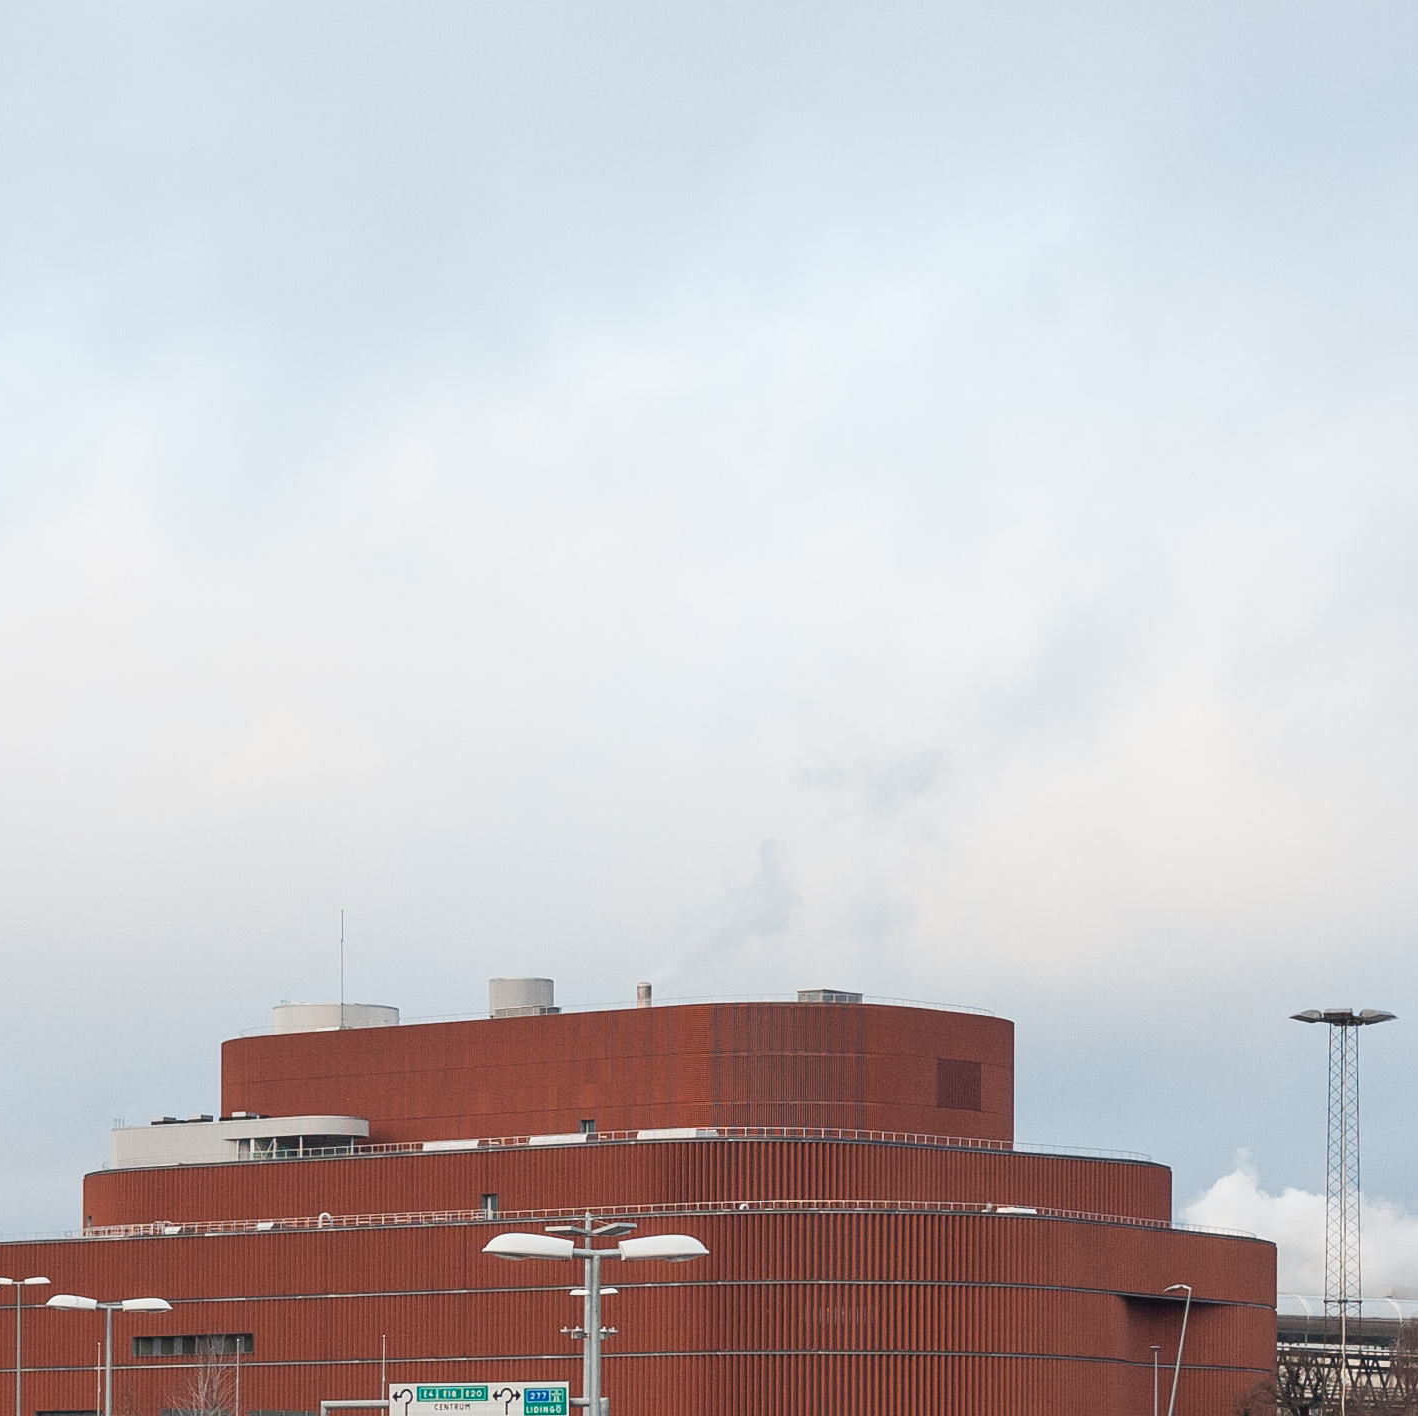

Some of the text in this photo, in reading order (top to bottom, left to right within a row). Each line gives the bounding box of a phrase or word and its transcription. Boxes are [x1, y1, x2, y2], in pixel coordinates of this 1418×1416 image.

[423, 1390, 483, 1398] E4 E18 E20
[530, 1392, 547, 1400] 277
[434, 1403, 471, 1411] CENTRUM
[526, 1404, 562, 1414] LIDINGÖ
